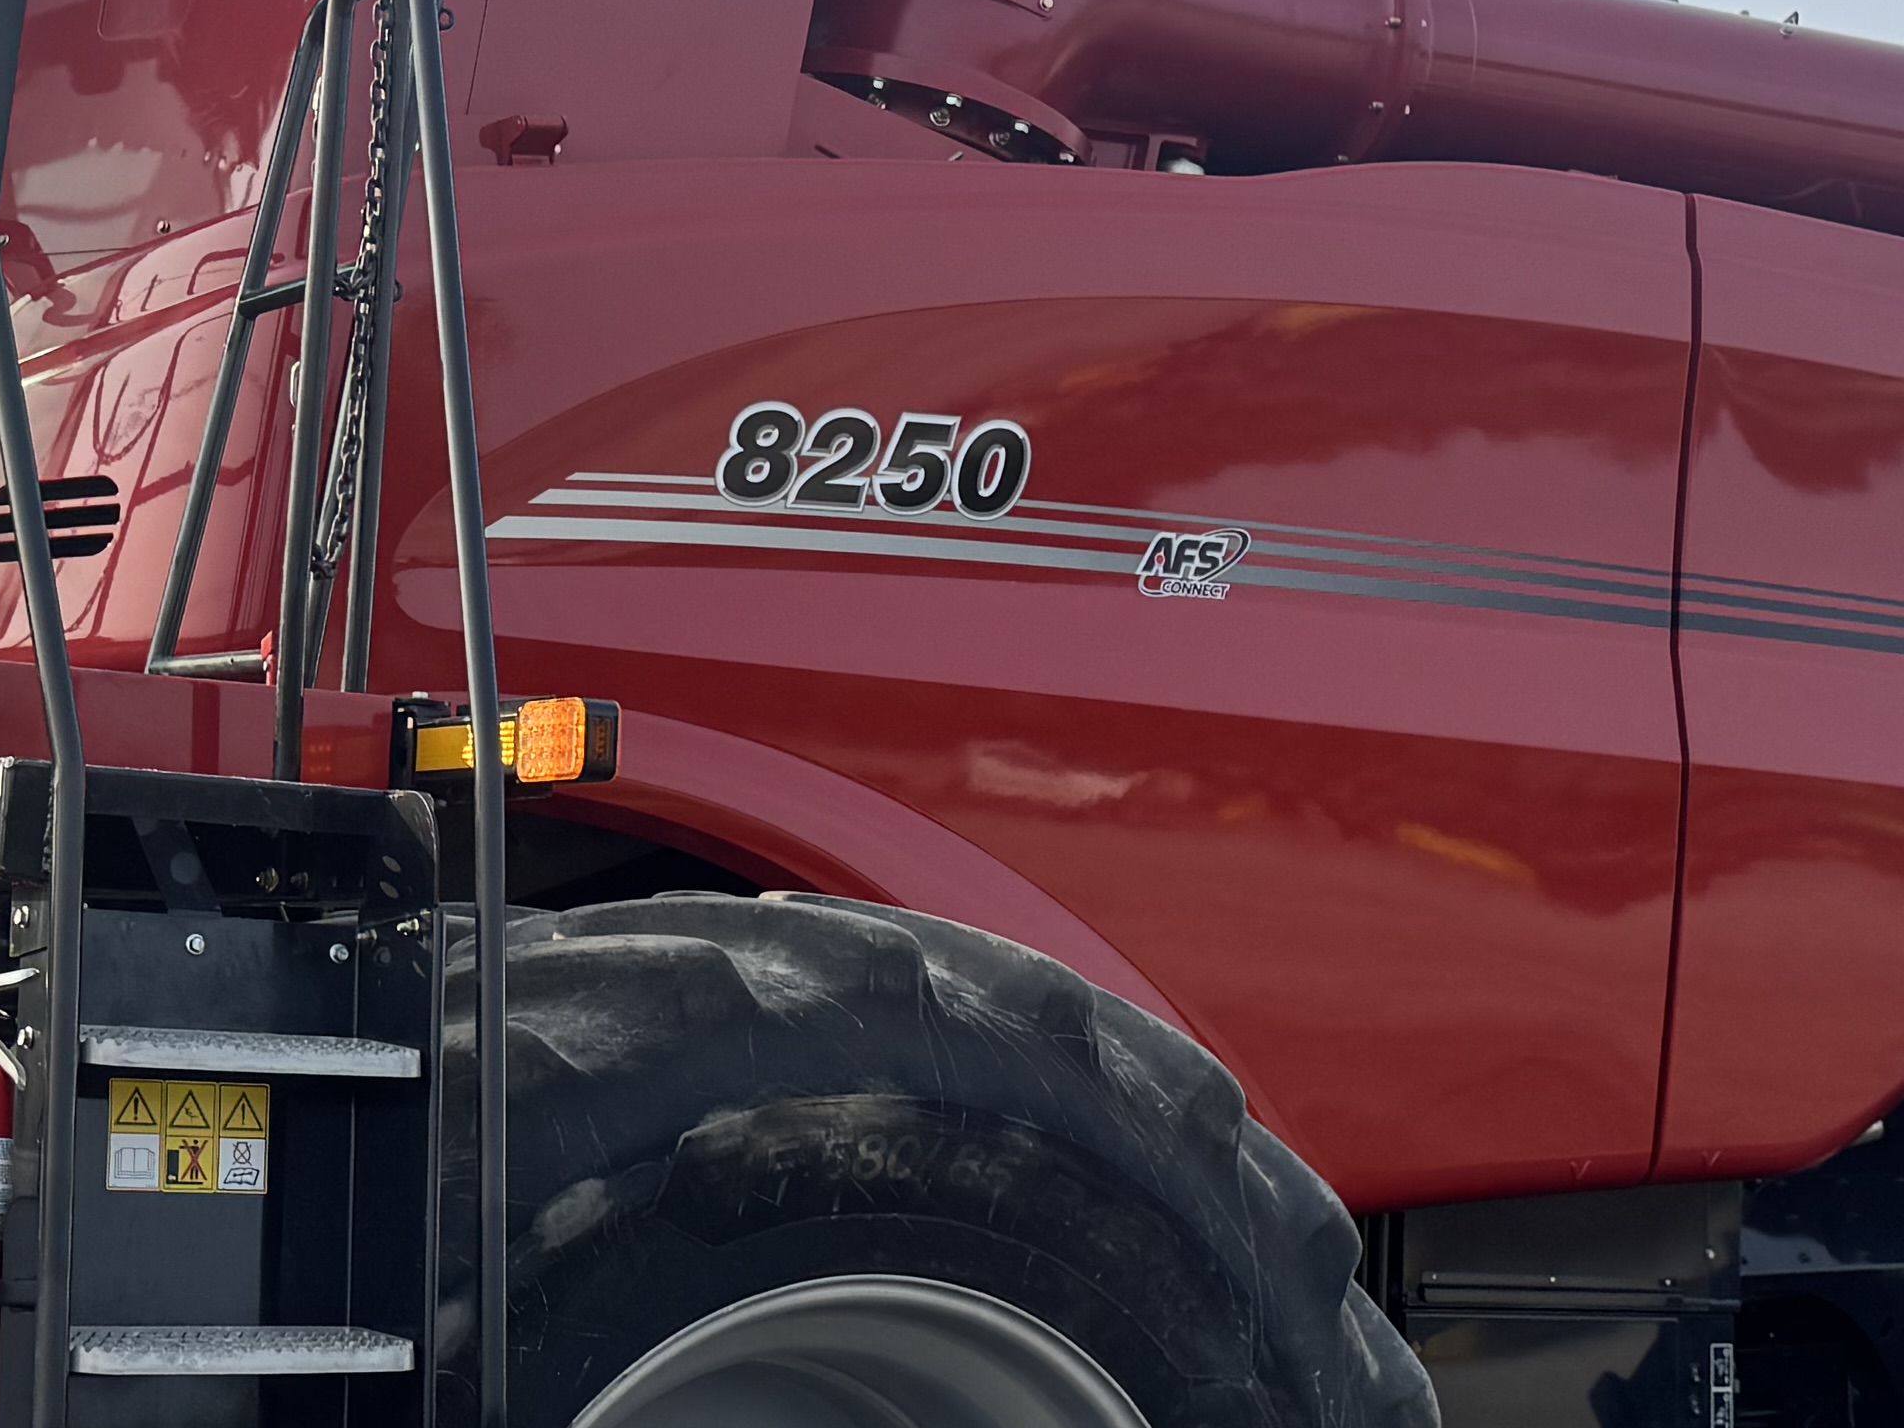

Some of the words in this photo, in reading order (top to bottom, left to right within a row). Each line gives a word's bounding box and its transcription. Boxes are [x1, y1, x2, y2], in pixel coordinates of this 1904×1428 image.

[715, 399, 1032, 521] 8250
[1139, 534, 1227, 580] AFS
[1162, 580, 1229, 600] CONNECT
